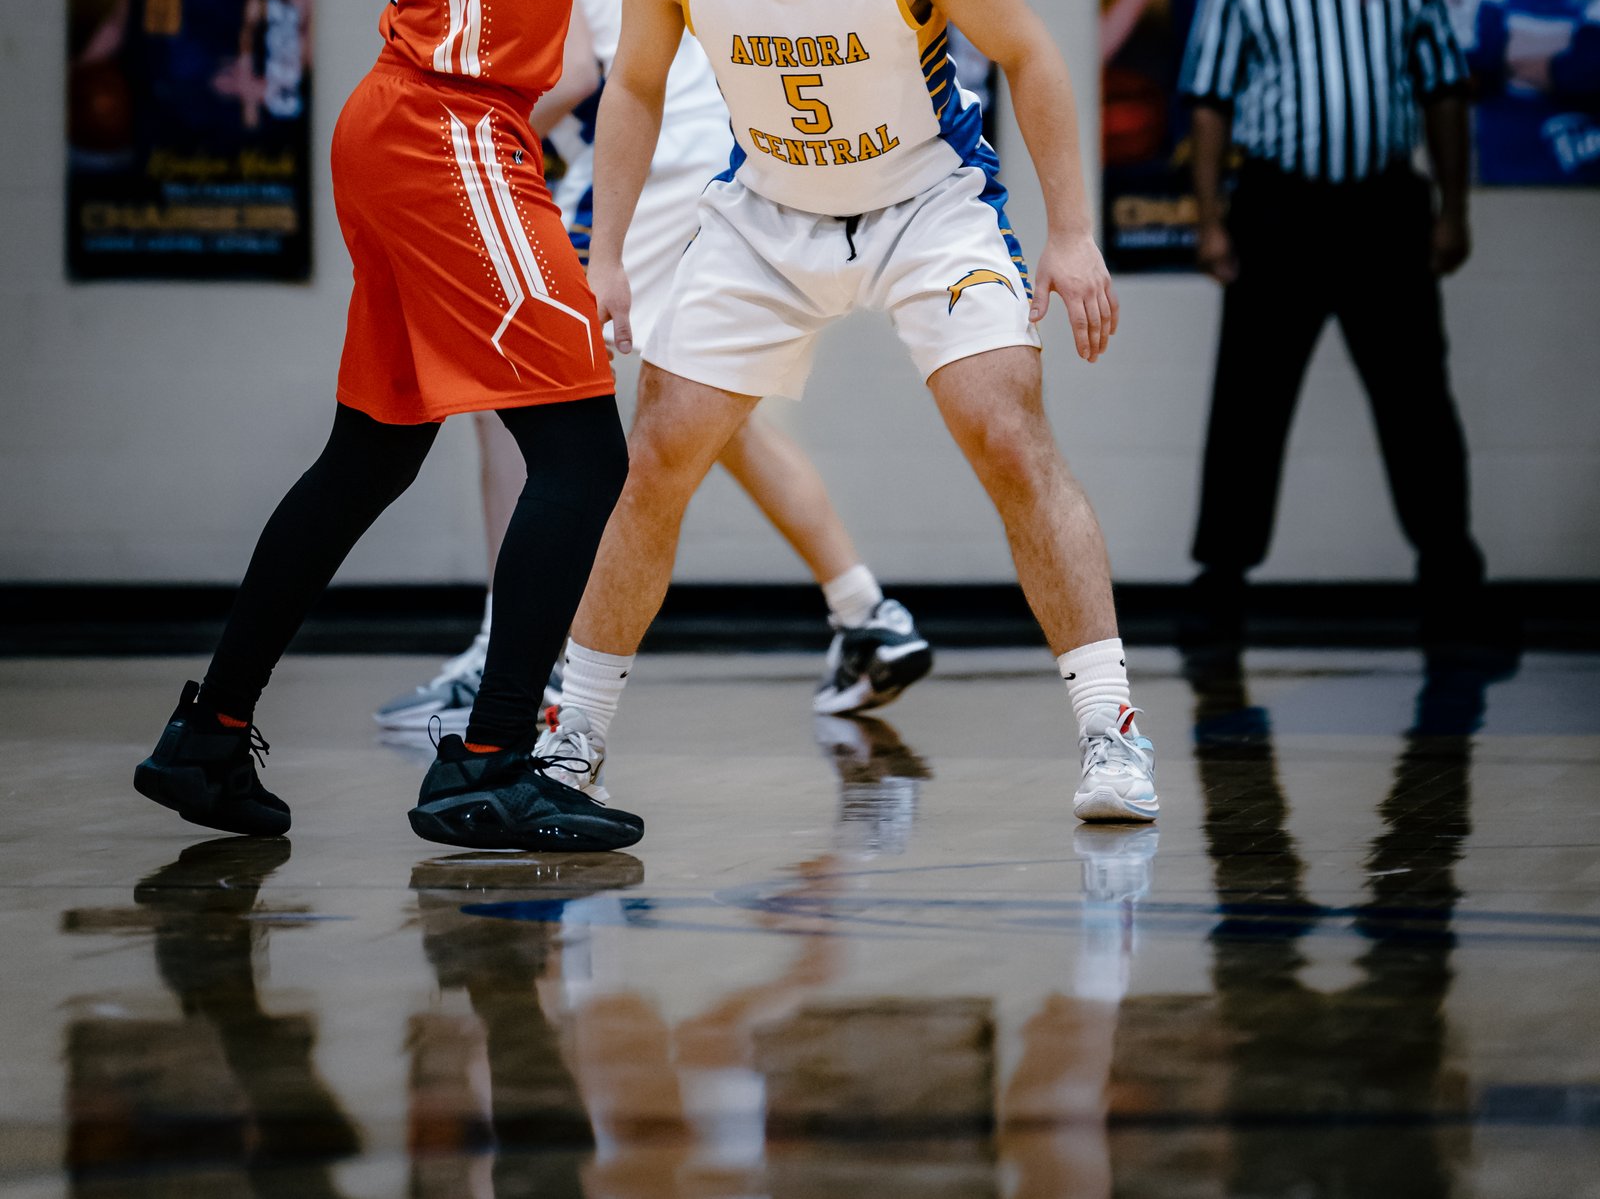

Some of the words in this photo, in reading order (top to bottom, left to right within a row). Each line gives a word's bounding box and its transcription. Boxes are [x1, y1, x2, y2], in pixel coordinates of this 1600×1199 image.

[731, 32, 870, 68] AURORA
[781, 73, 834, 135] 5
[748, 123, 901, 167] CENTRAL
